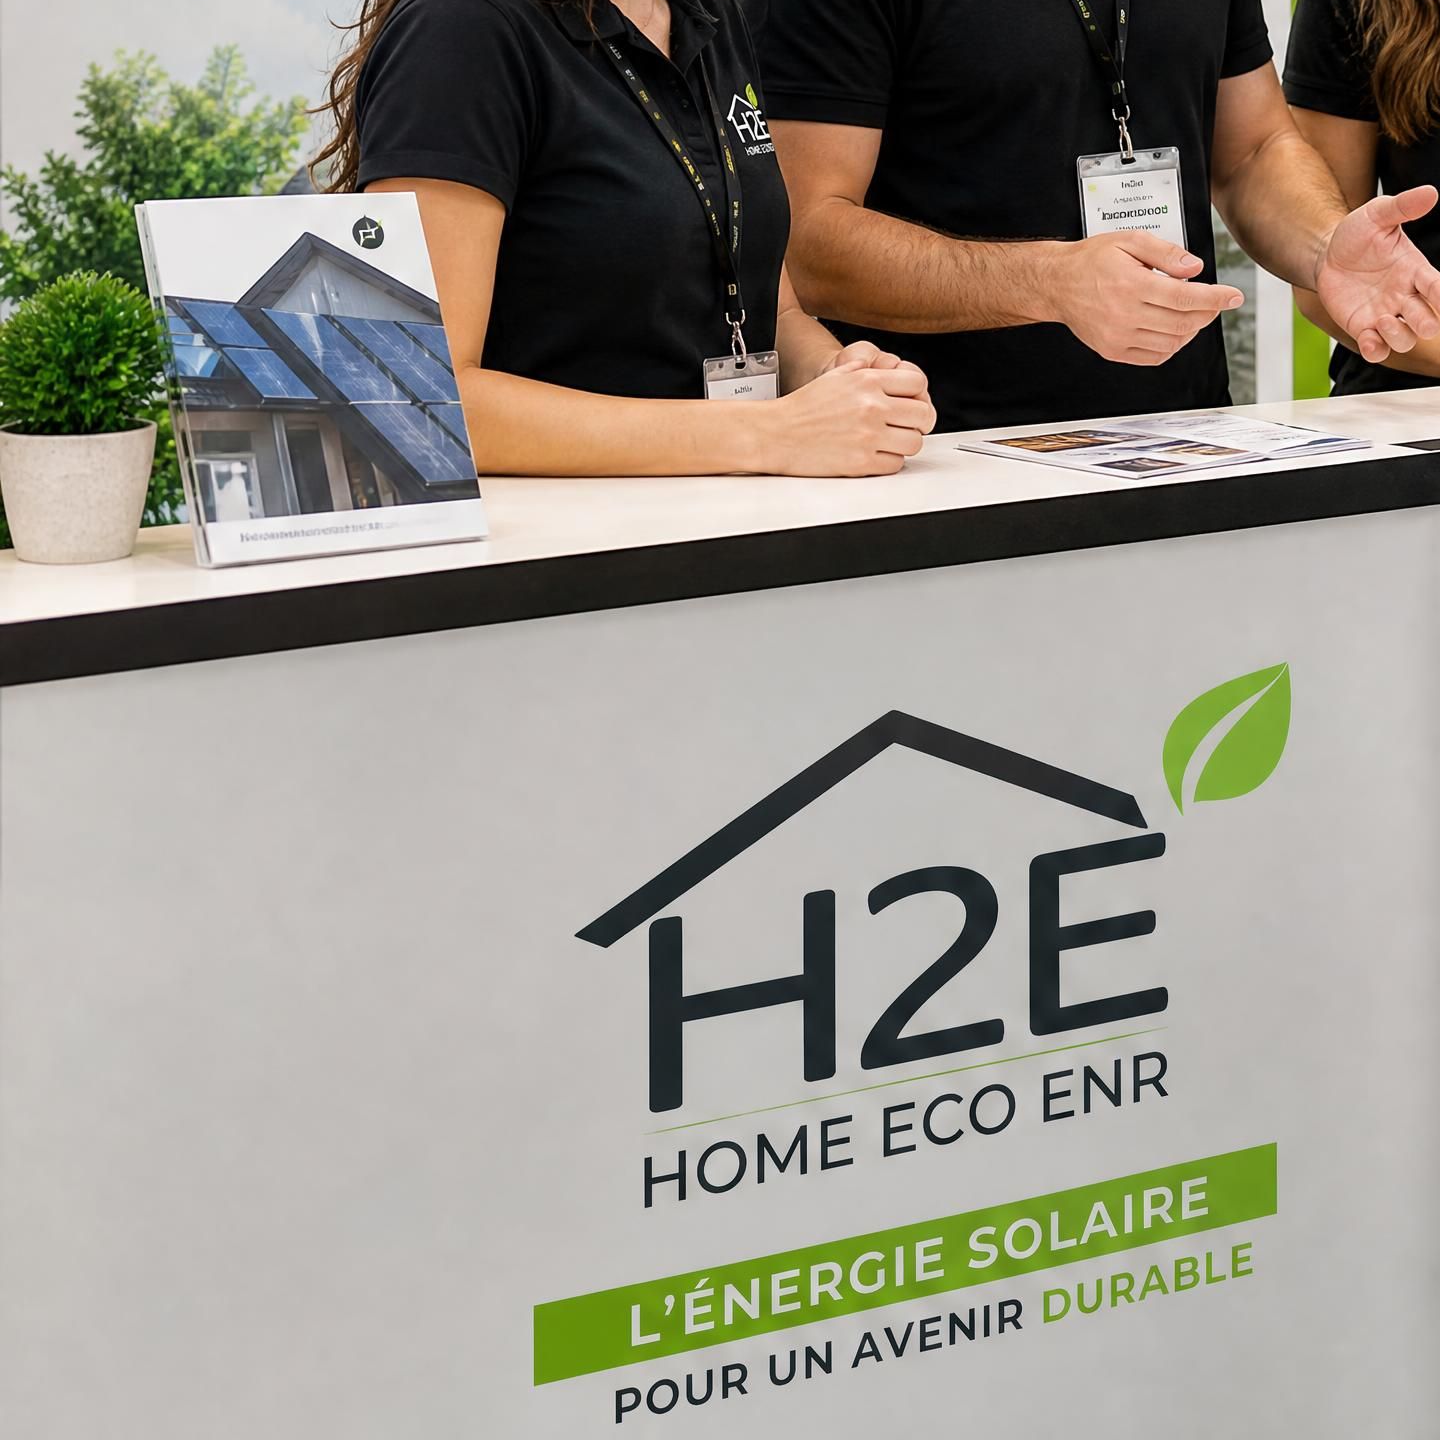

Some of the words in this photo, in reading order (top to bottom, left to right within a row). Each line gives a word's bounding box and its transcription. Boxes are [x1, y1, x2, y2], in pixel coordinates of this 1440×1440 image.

[648, 832, 1169, 1114] H2E
[642, 1113, 855, 1209] HOME
[881, 1082, 1016, 1158] ECO
[1041, 1051, 1170, 1123] ENR
[614, 1362, 749, 1425] POUR
[768, 1340, 833, 1387] UN
[850, 1297, 1024, 1369] AVENIR
[1041, 1241, 1254, 1324] DURABLE
[629, 1236, 946, 1348] L'ÉNERGIE
[966, 1175, 1210, 1270] SOLAIRE
